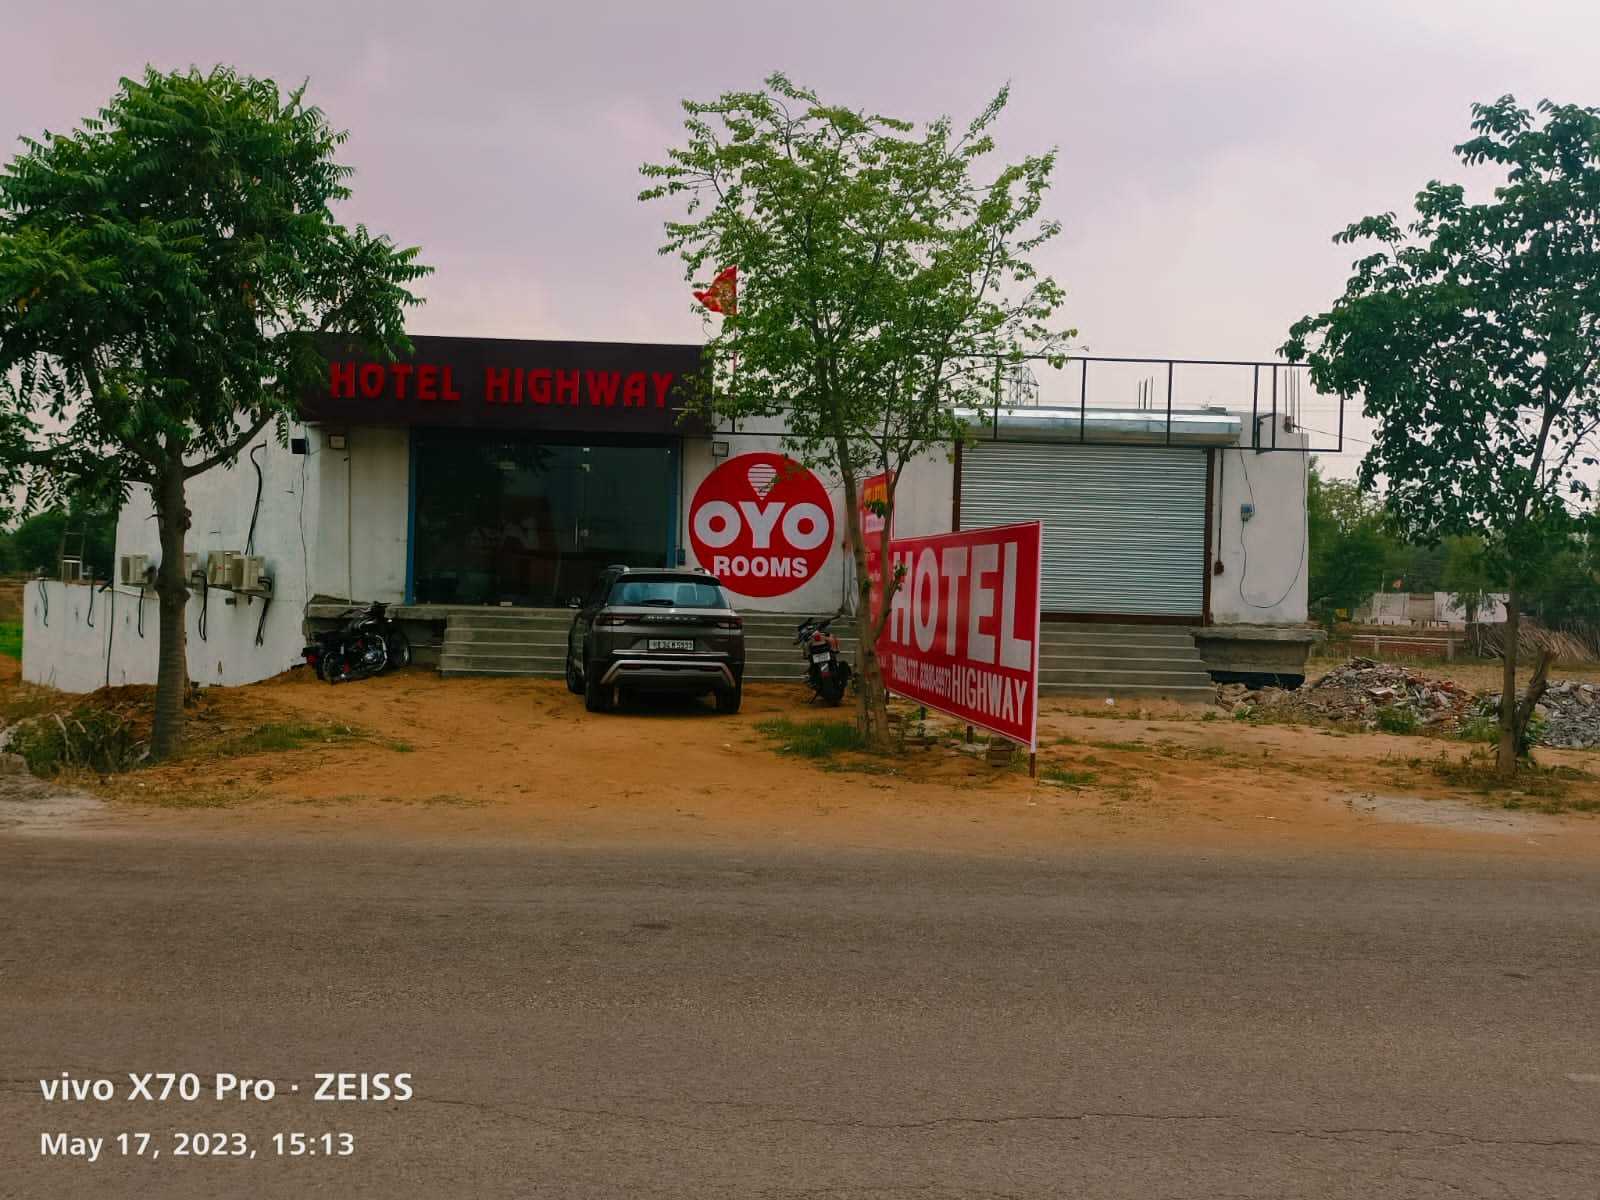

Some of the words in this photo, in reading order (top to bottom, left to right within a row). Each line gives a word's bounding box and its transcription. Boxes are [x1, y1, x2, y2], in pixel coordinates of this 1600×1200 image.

[330, 361, 461, 400] HOTEL
[485, 366, 674, 408] HIGHWAY
[694, 500, 830, 550] OYO
[713, 555, 809, 578] ROOMS
[889, 541, 1032, 672] HOTEL
[951, 664, 1028, 726] HIGHWAY
